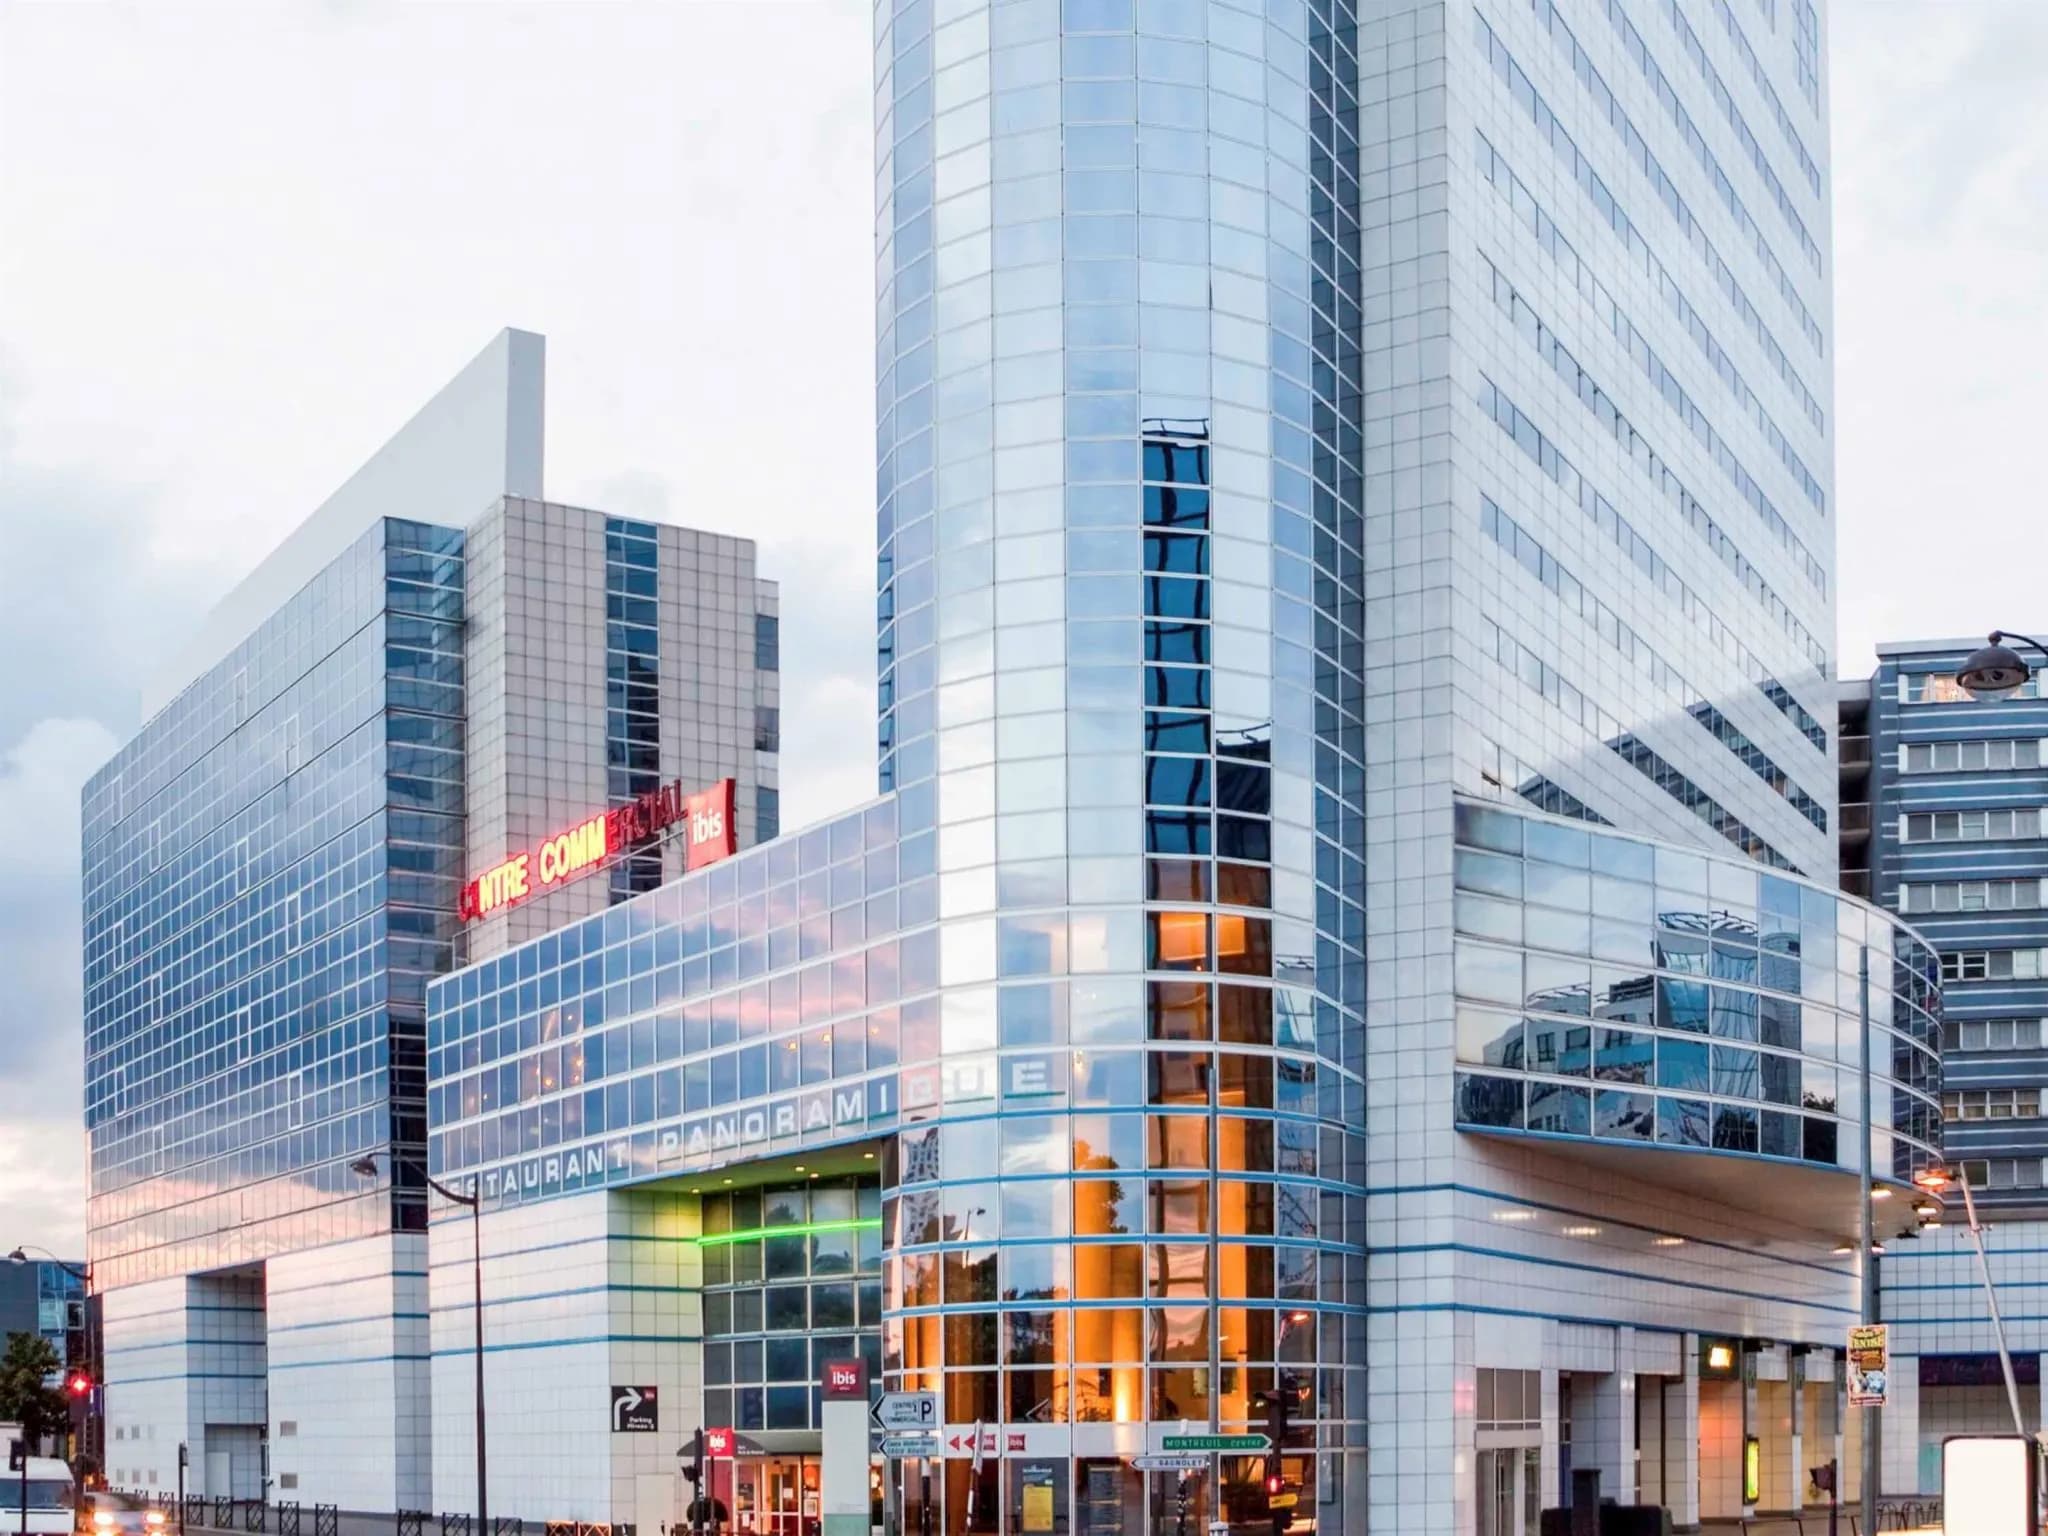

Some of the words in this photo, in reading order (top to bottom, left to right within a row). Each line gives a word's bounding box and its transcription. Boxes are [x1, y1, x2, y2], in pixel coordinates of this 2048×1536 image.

[539, 779, 688, 885] COMMERCIAL
[692, 809, 723, 844] ibis
[663, 1061, 1047, 1153] PANORAMIQUE
[832, 1371, 856, 1385] ibis
[921, 1401, 932, 1422] P
[710, 1434, 726, 1448] ibis
[1165, 1438, 1222, 1448] MONTREUIL
[1159, 1459, 1203, 1467] BAGNOLET
